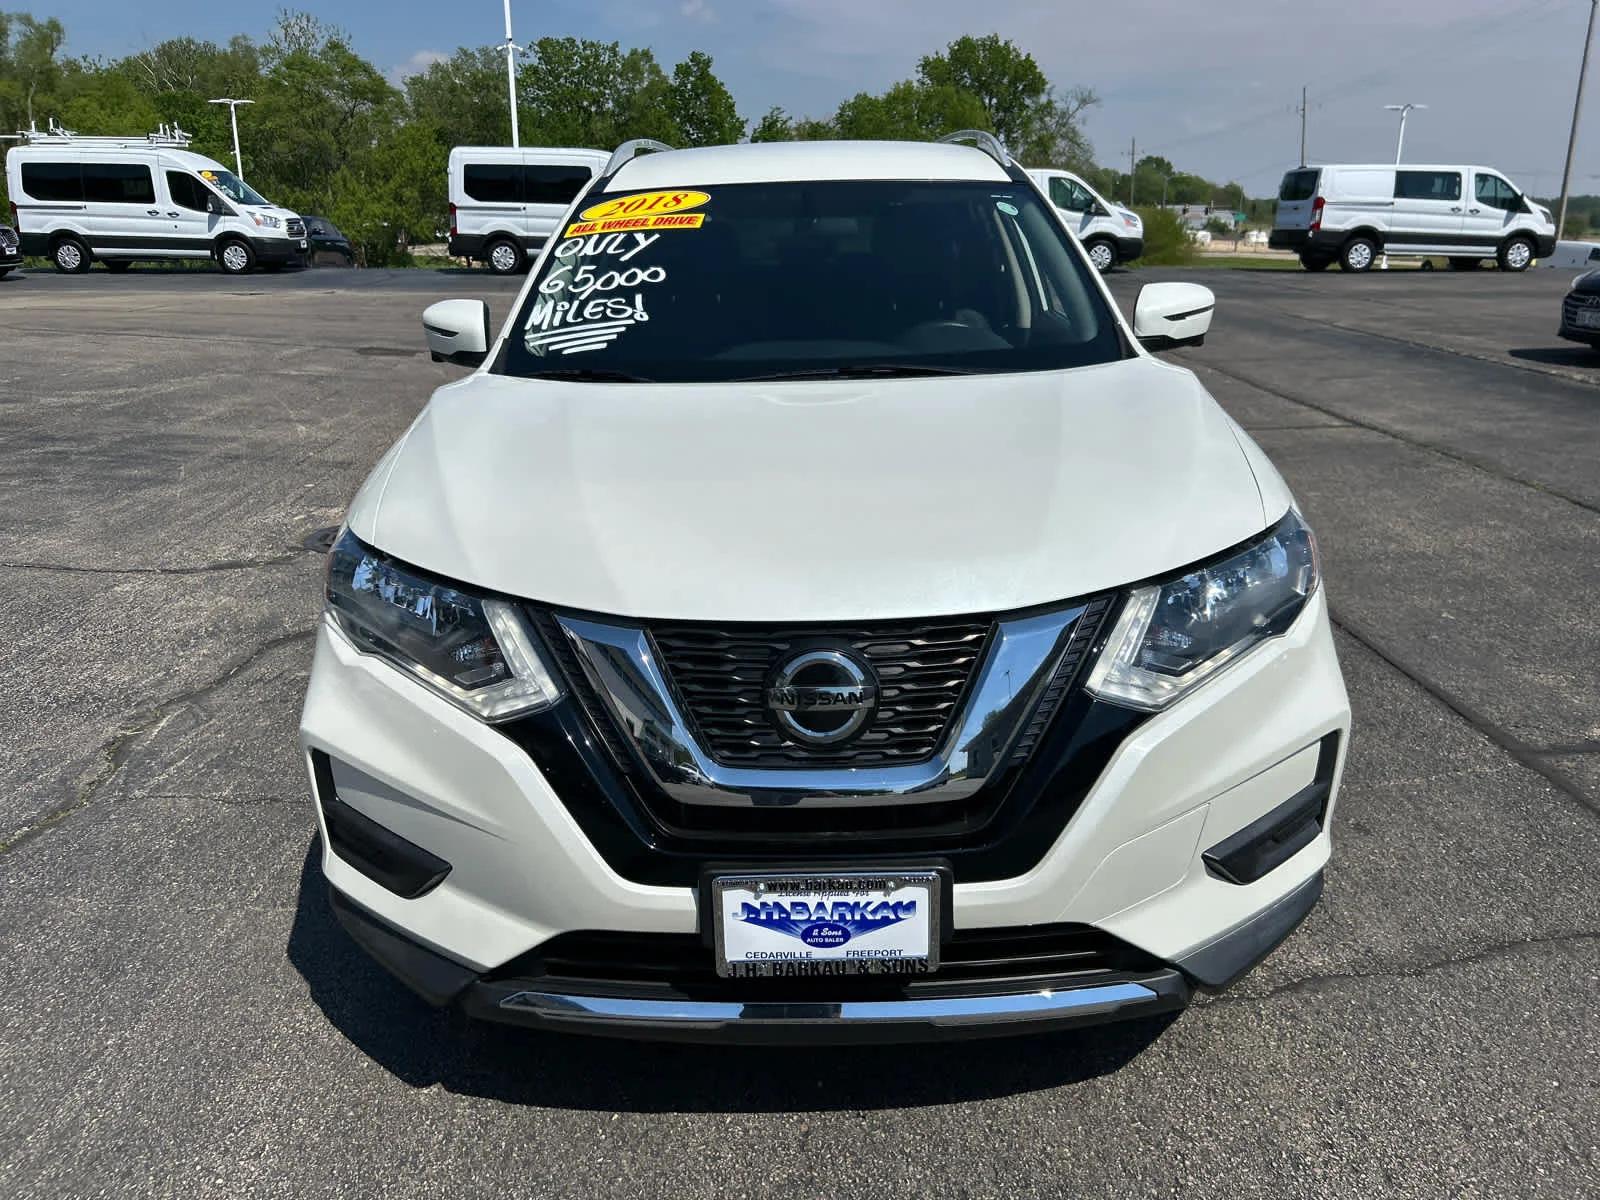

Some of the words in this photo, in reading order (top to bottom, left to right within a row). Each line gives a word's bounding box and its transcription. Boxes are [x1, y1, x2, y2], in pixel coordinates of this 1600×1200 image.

[600, 193, 688, 217] 2018
[571, 224, 597, 234] ALL
[600, 219, 650, 229] WHEEL
[653, 215, 699, 226] DRIVE
[554, 232, 660, 261] ONLY
[539, 265, 666, 299] 65,000
[779, 690, 864, 705] NISSAN
[767, 878, 887, 891] www.barkau.com
[821, 928, 843, 937] Sons
[745, 951, 813, 960] CEDARVILLE
[846, 949, 904, 958] FREEPORT
[772, 960, 848, 976] BARKAU
[880, 958, 929, 974] SONS
